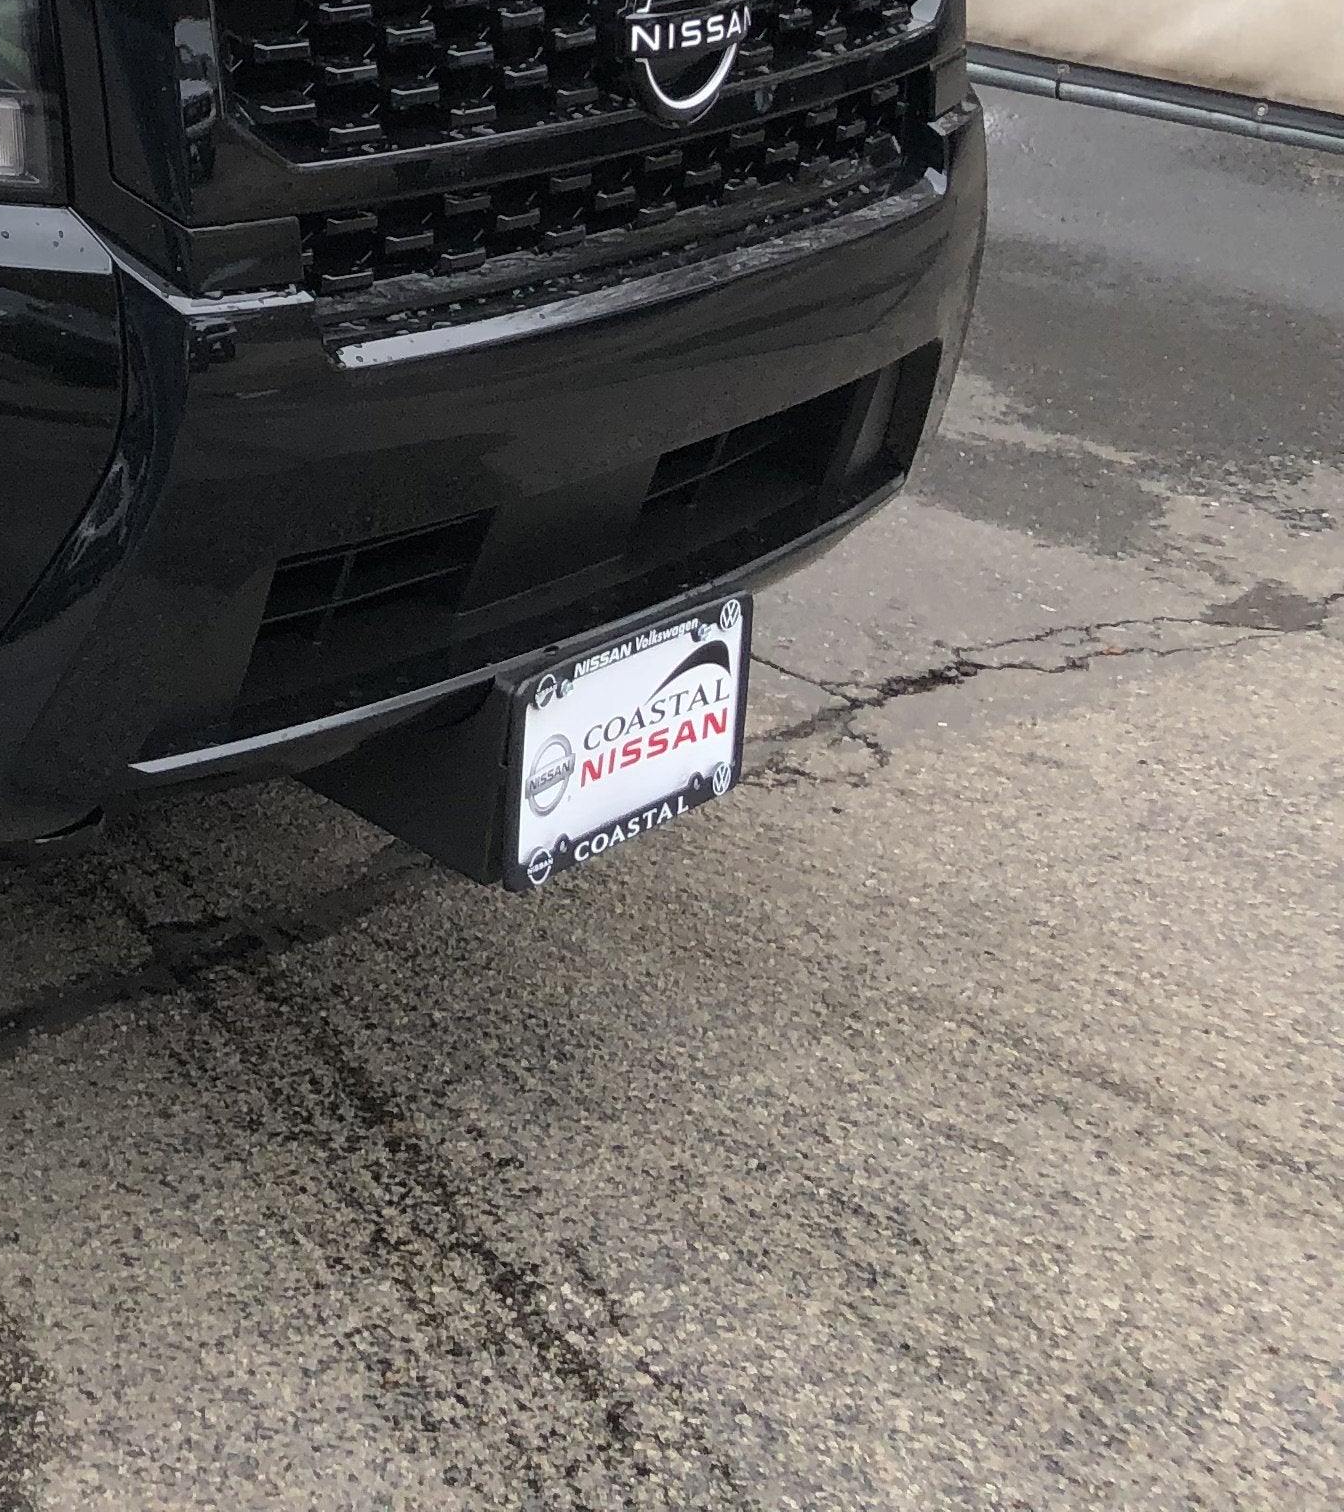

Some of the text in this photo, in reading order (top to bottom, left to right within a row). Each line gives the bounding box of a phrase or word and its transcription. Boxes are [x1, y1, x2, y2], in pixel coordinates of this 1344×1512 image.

[630, 4, 752, 53] NISSAN
[573, 617, 699, 679] NISSAN Volkswagen
[583, 677, 730, 752] COASTAL
[529, 758, 572, 792] NISSAN
[579, 707, 729, 788] NISSAN
[573, 795, 690, 863] COASTAL
